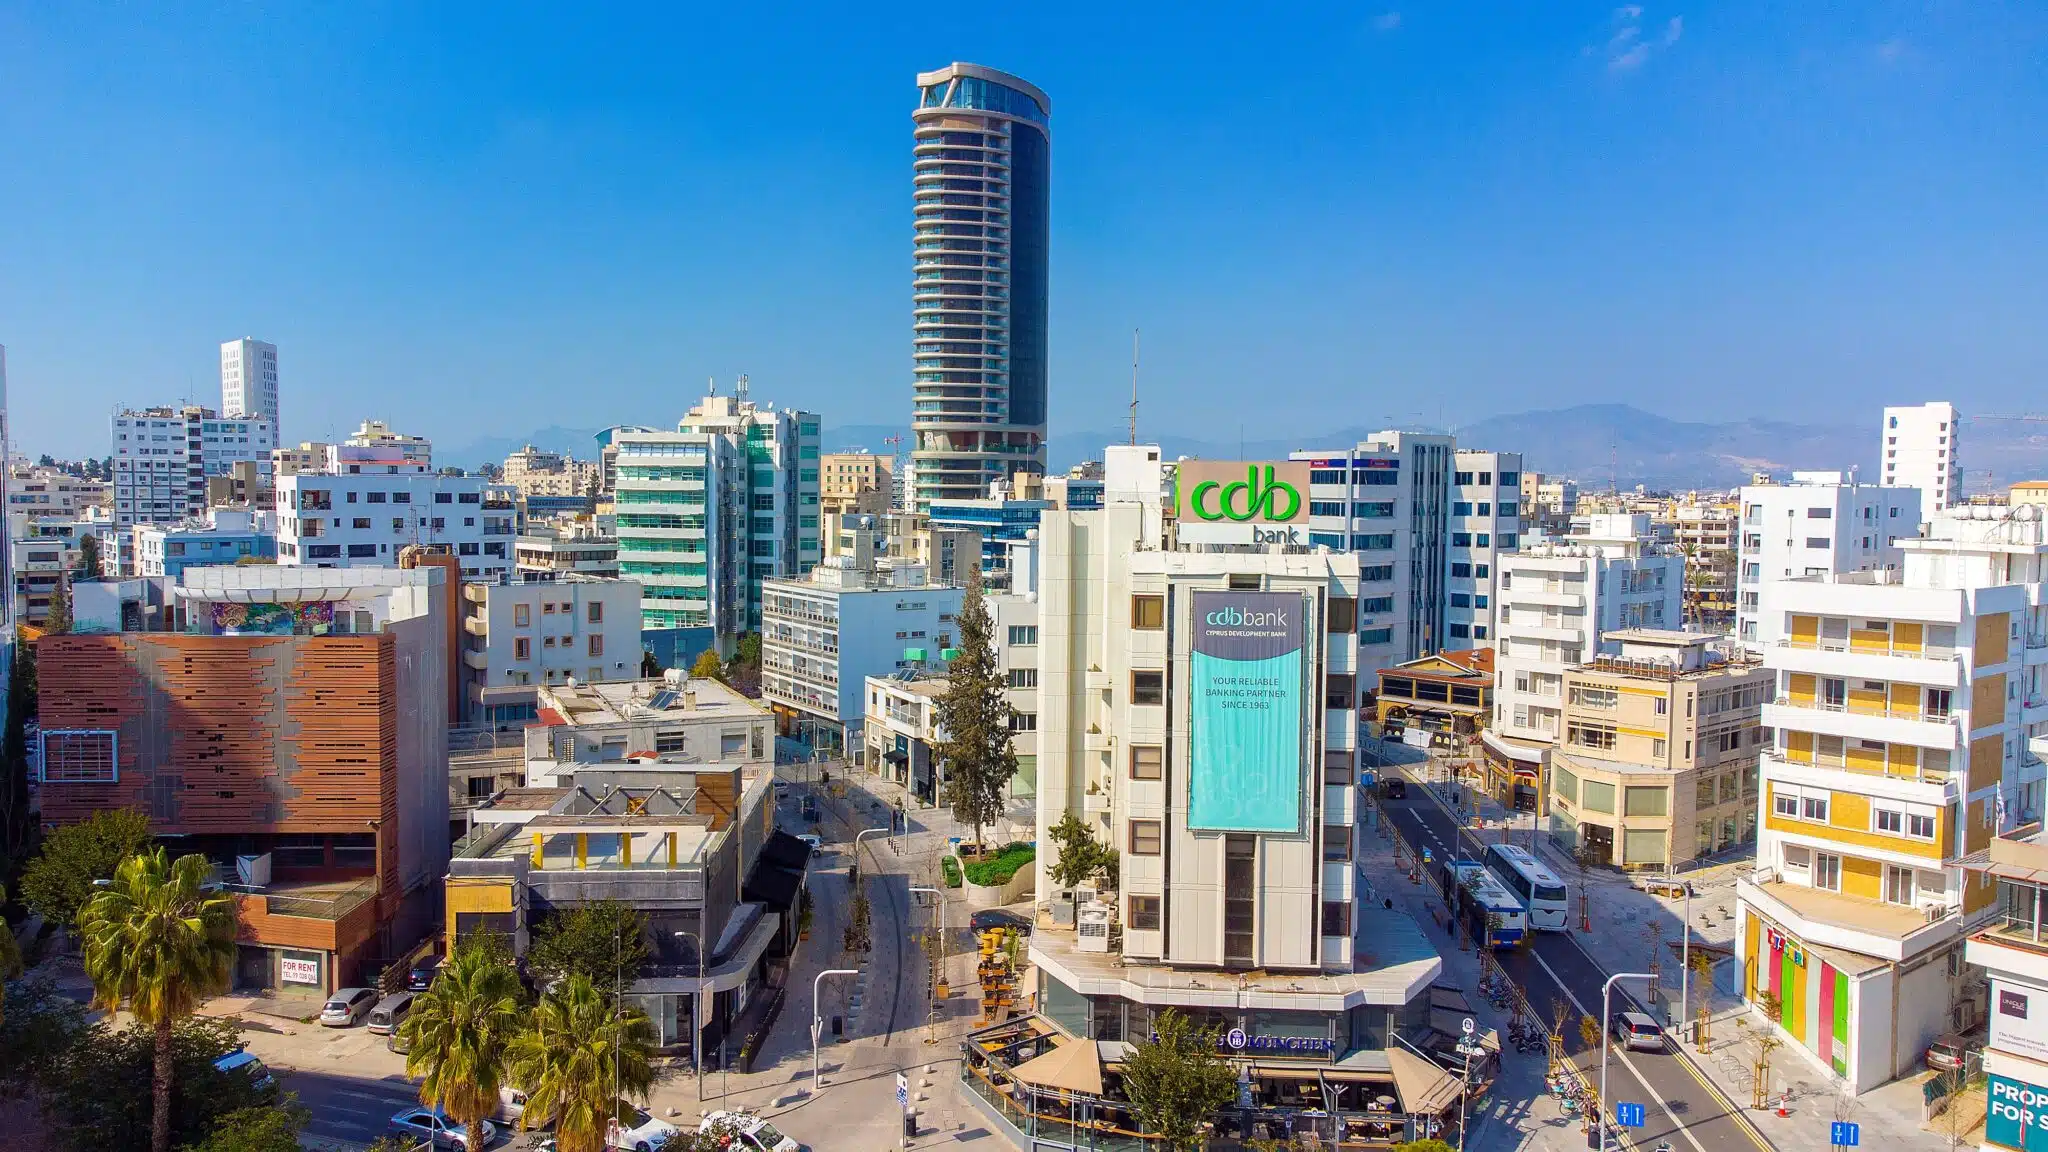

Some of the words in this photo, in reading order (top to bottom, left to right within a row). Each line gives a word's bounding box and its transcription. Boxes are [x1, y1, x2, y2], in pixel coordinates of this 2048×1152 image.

[1191, 464, 1301, 521] cdb
[1253, 525, 1300, 546] bank
[1228, 630, 1269, 638] DEVELOPMENT
[1212, 676, 1237, 685] YOUR
[1239, 677, 1279, 686] RELIABLE
[1206, 688, 1245, 697] BANKING
[1246, 689, 1286, 698] PARTNER
[1222, 700, 1248, 709] SINCE
[283, 961, 296, 971] FOR
[298, 962, 316, 973] RENT
[2002, 999, 2025, 1008] UNIQUE
[1247, 1032, 1335, 1051] MÜNCHEN
[1992, 1101, 2033, 1126] FOR
